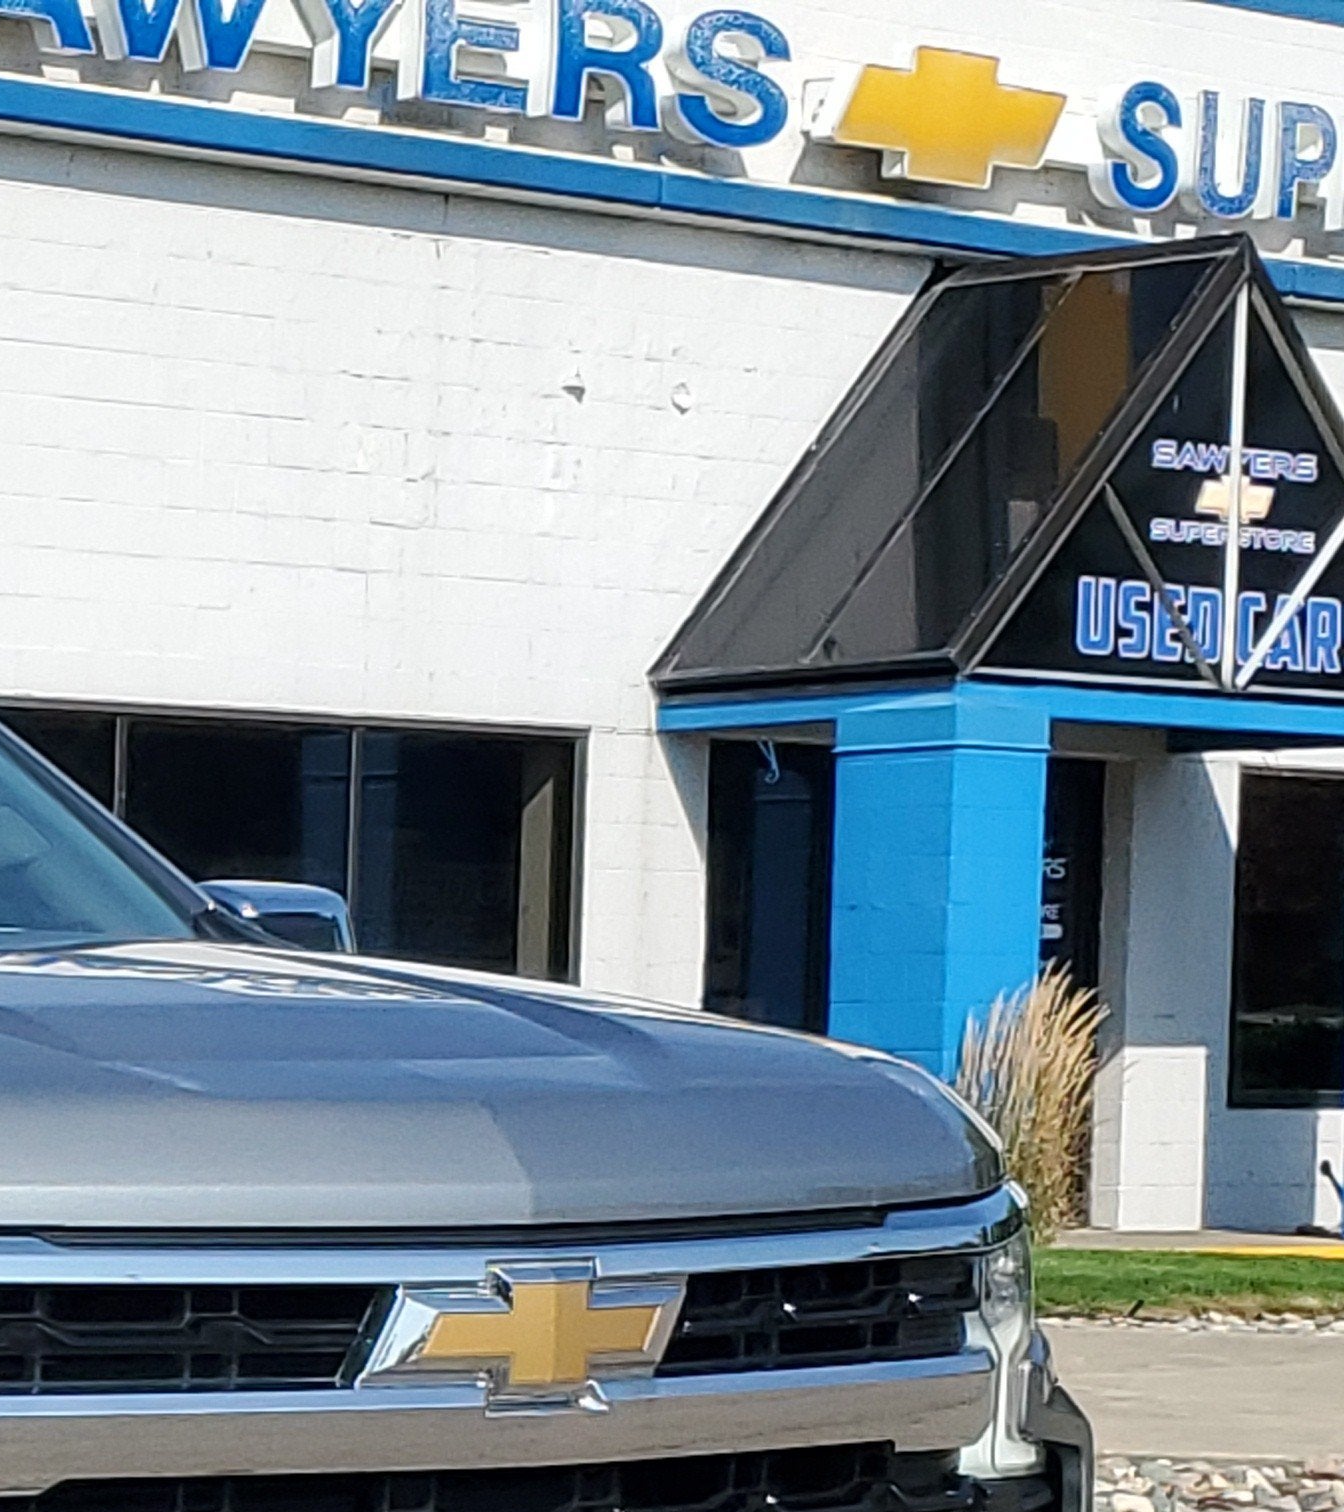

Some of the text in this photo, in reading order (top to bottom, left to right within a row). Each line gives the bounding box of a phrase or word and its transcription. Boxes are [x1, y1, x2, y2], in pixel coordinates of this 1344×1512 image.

[1109, 80, 1338, 220] SUP
[1076, 575, 1343, 674] USED CAR
